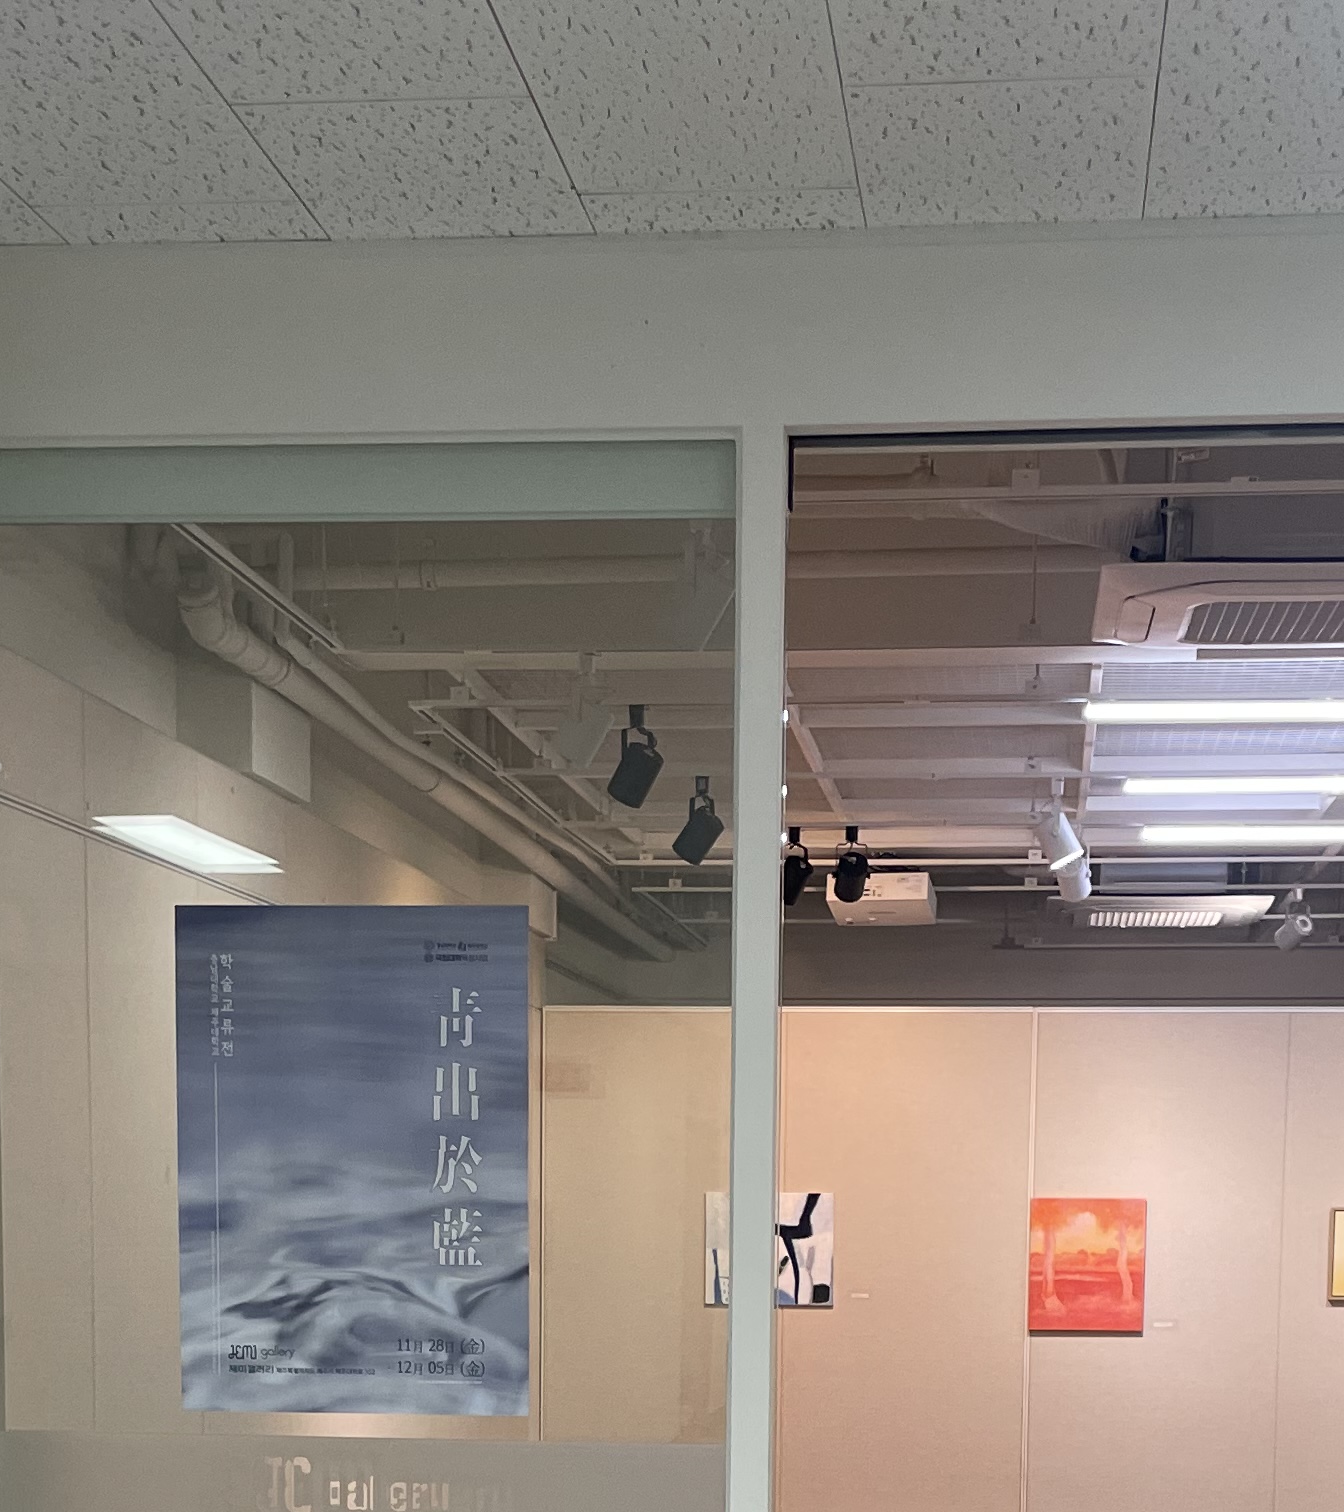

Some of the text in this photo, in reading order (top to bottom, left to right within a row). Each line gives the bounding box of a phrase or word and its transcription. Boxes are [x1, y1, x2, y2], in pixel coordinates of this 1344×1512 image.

[219, 953, 235, 1057] 학술교류전
[261, 1344, 296, 1360] gallery
[397, 1338, 485, 1354] 11月 28日 (金)
[397, 1360, 485, 1377] 12月 05日 (金)
